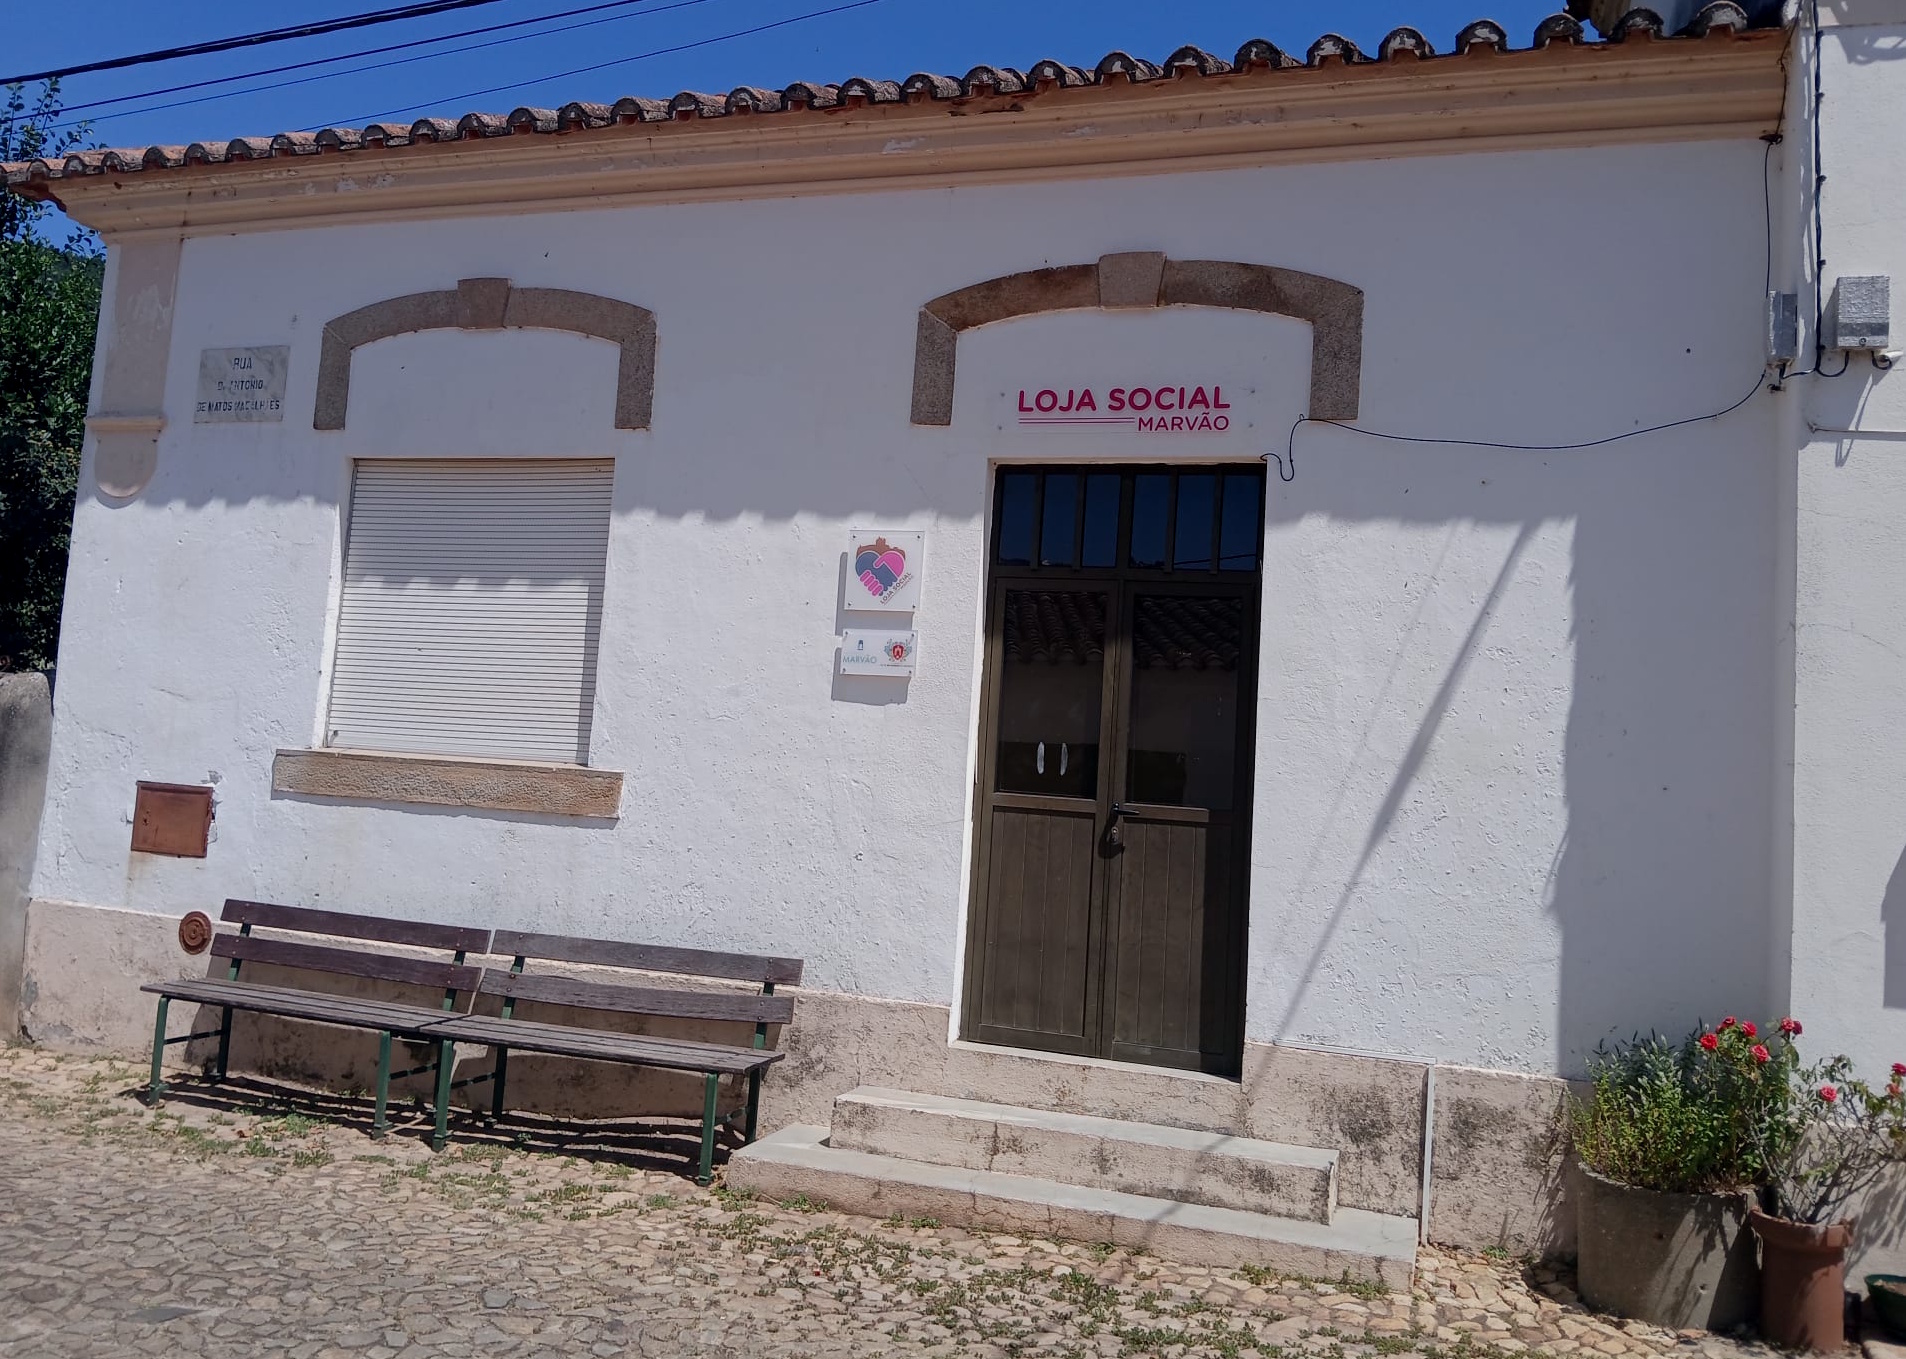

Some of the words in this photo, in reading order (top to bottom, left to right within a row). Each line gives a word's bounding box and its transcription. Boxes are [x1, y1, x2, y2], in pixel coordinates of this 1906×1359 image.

[232, 358, 253, 370] RUA
[208, 401, 233, 412] MATOS
[1018, 389, 1097, 412] LOJA
[1108, 386, 1231, 411] SOCIAL
[1138, 412, 1229, 431] MARVÃO
[880, 590, 894, 604] LOJA
[892, 572, 912, 591] SOCIAL
[842, 654, 877, 664] MARVÃO
